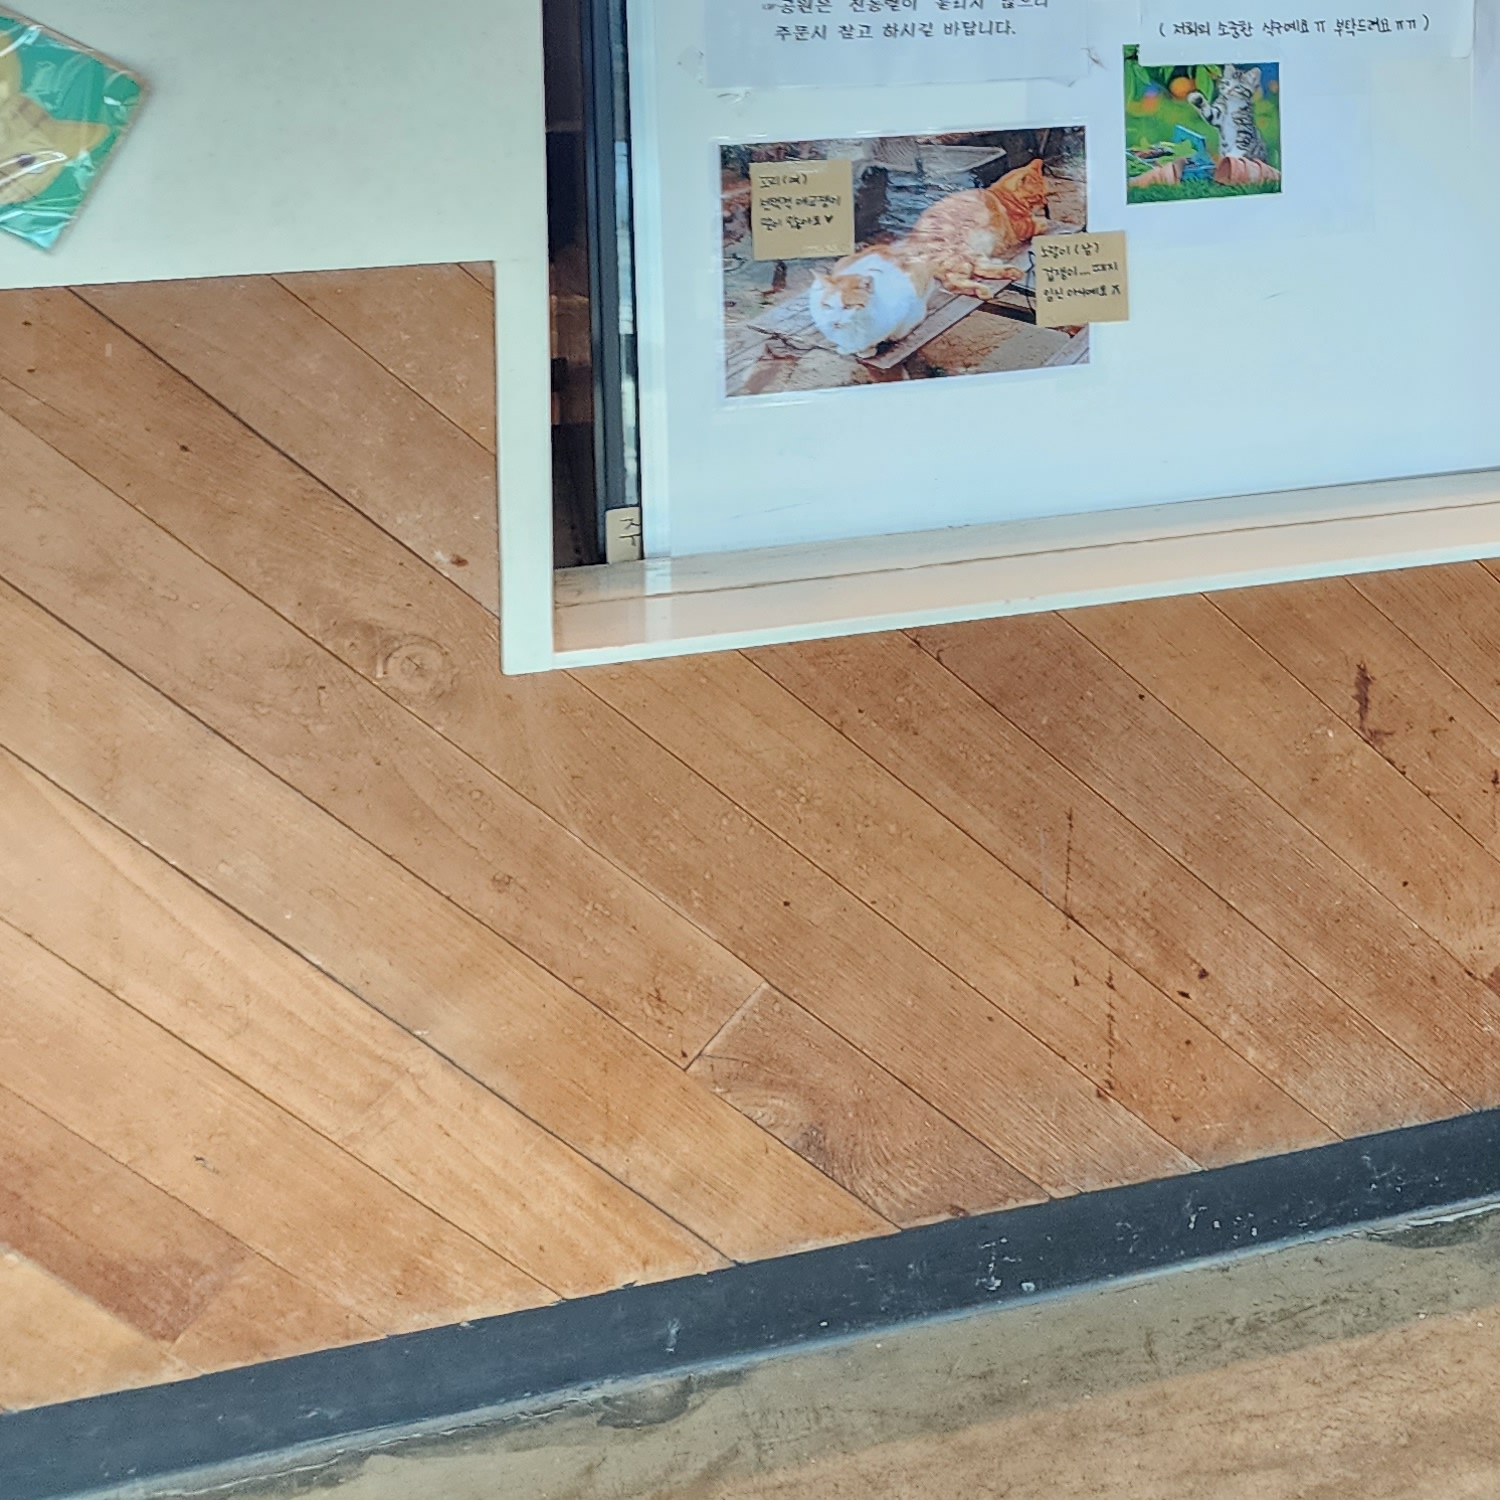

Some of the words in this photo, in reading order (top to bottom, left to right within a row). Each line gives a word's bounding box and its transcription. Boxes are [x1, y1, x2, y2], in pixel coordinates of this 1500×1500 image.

[774, 24, 828, 41] 주문시
[837, 22, 874, 40] 참고
[881, 20, 934, 38] 하시길
[1217, 19, 1254, 39] 소중한
[1333, 16, 1393, 38] 부탁드려요
